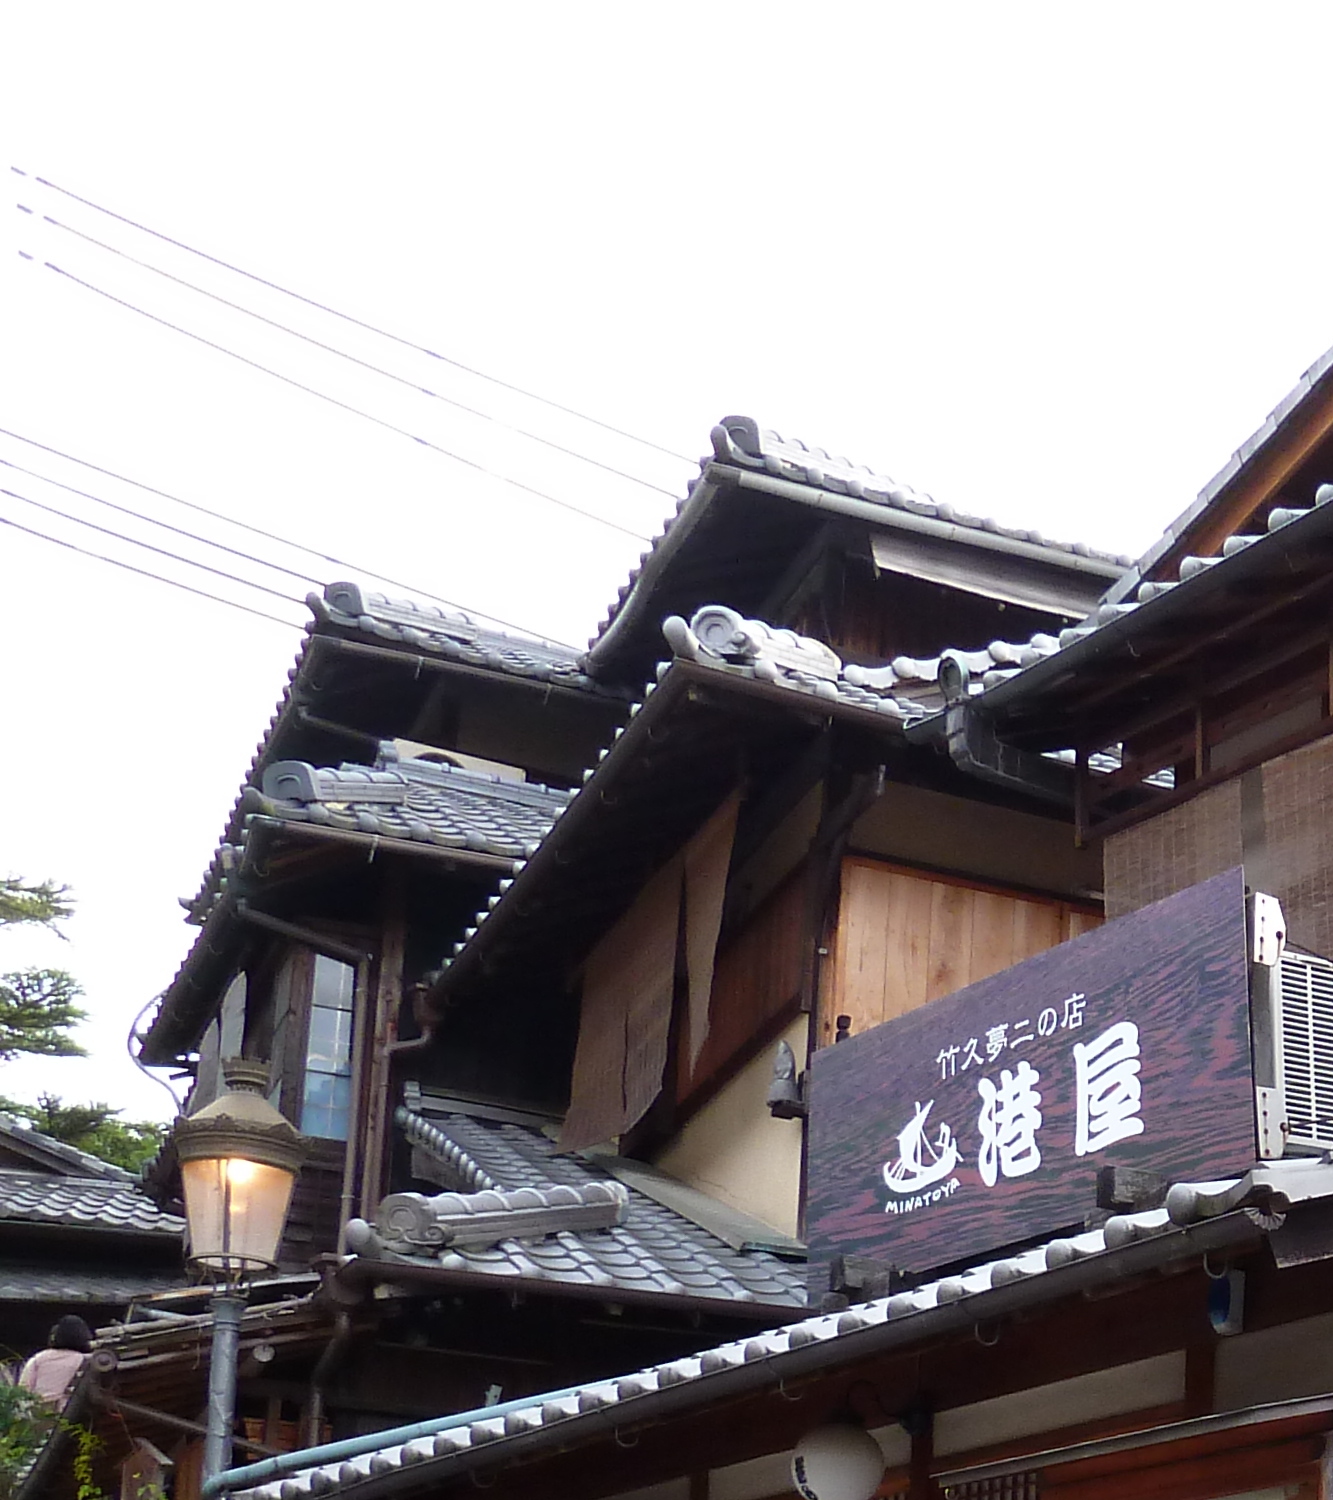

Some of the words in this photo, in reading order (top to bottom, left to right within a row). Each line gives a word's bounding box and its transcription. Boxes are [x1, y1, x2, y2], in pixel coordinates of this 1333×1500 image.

[936, 993, 1086, 1080] 竹久夢二の店
[977, 1021, 1144, 1187] 港屋
[884, 1177, 961, 1214] MINATOYA
